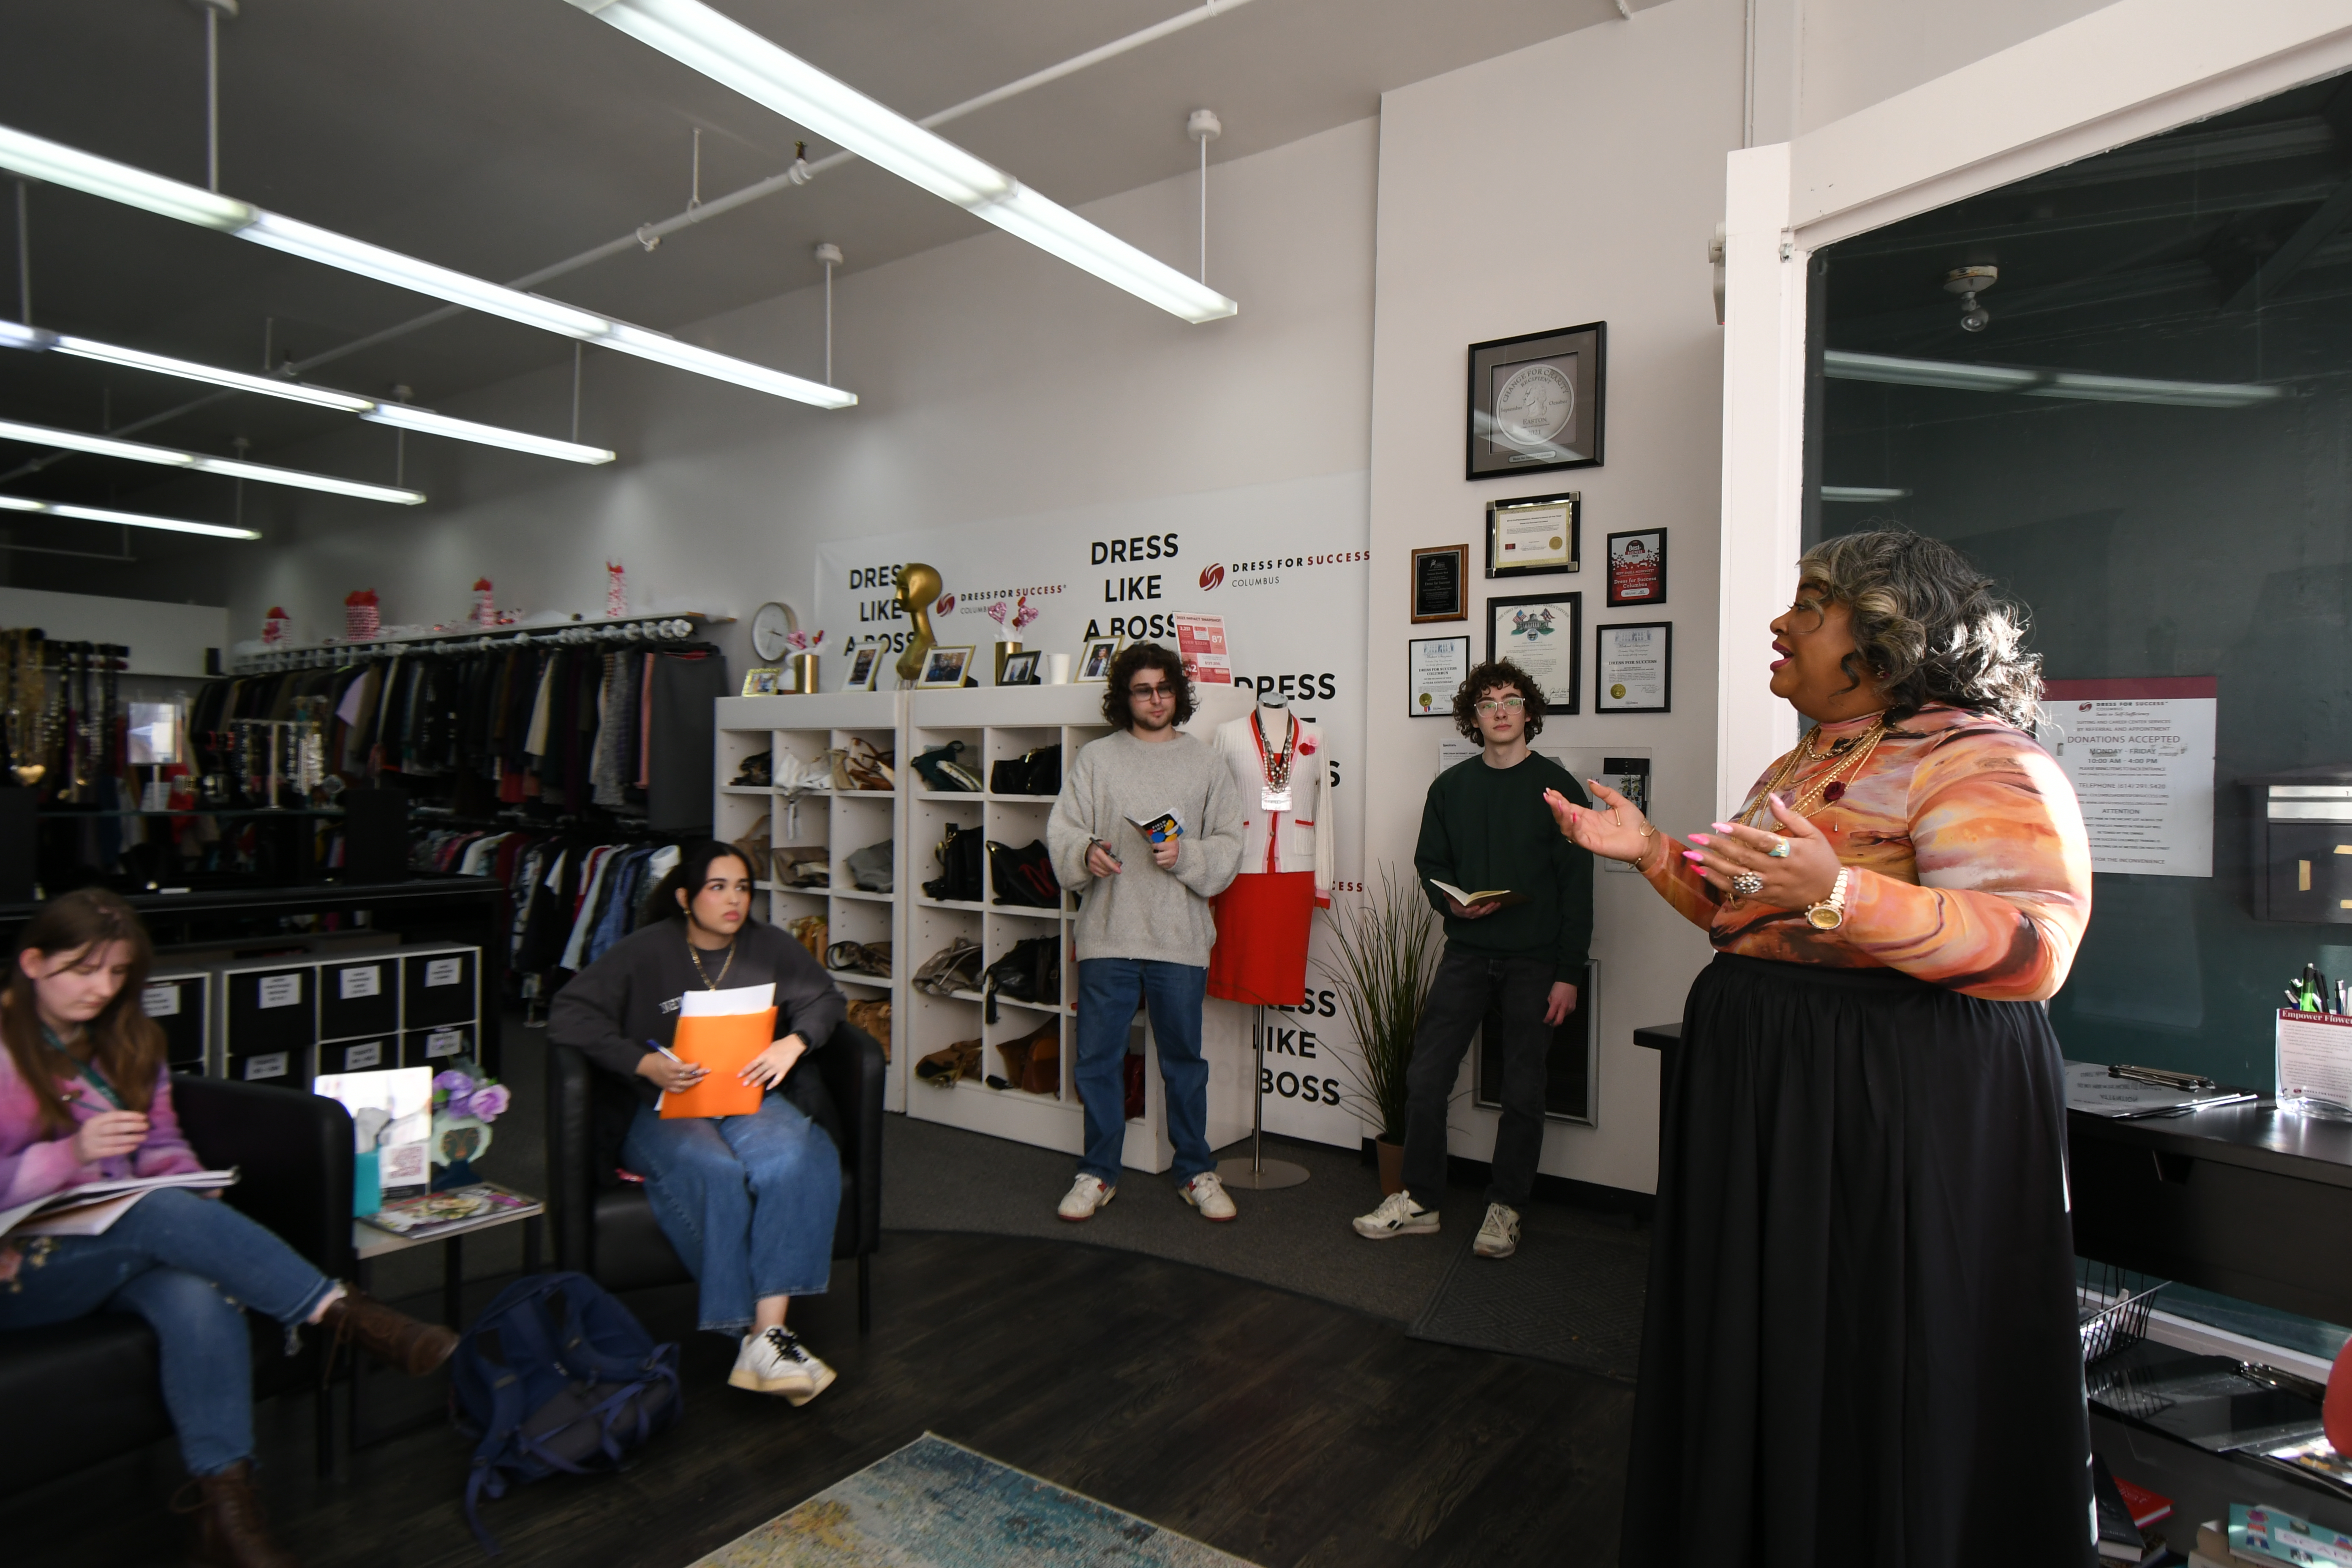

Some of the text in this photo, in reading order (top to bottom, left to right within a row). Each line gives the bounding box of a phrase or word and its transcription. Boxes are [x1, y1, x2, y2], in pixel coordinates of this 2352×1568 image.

[1503, 369, 1569, 403] CHANGE FOR CHARITY
[1521, 376, 1552, 387] RECIPIENT
[1092, 533, 1179, 565] DRESS
[1232, 551, 1370, 572] DRESS FOR SUCCESS
[849, 564, 903, 590] DRES
[1232, 576, 1279, 587] COLUMBUS
[960, 591, 991, 602] DRESS
[994, 590, 1013, 599] FOR
[1105, 575, 1161, 602] LIKE
[860, 599, 903, 622] LIKE
[960, 606, 988, 615] COLUMB
[1083, 619, 1100, 642] A
[844, 636, 855, 656] A
[1152, 820, 1166, 830] FIELD
[2282, 1010, 2322, 1021] Empower
